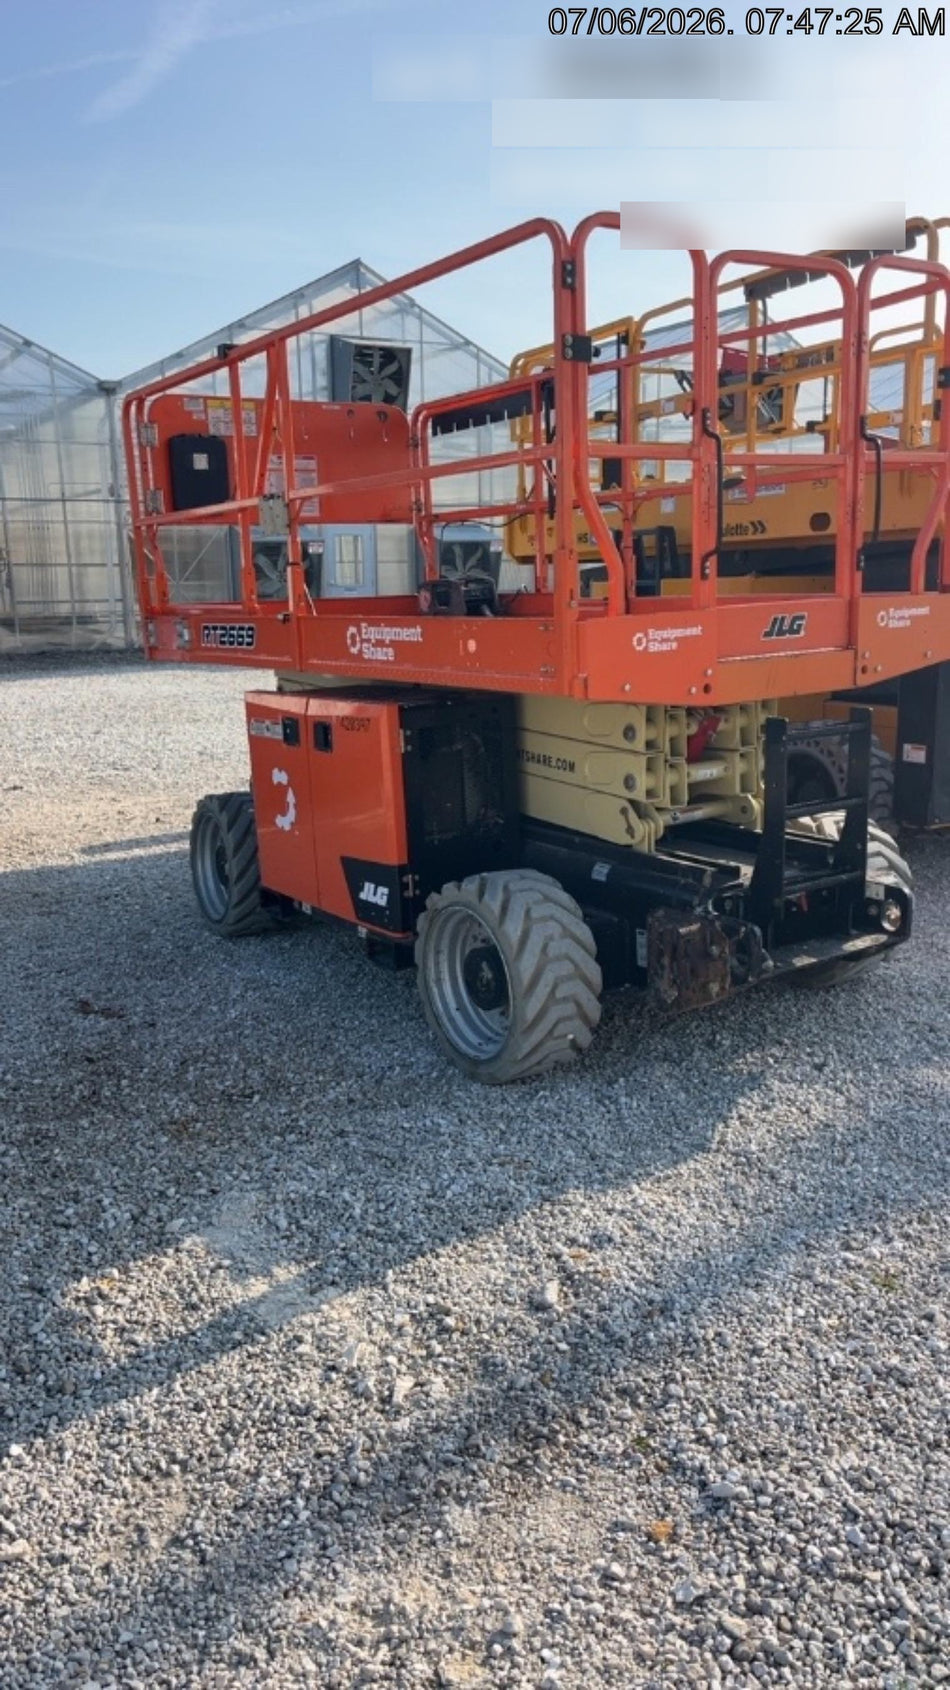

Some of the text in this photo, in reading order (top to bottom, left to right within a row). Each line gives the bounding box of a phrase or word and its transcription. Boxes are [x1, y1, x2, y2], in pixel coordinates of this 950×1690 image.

[201, 623, 256, 648] RT2669
[360, 622, 423, 644] Equipment
[647, 624, 703, 641] Equipment
[760, 612, 807, 640] JLG
[361, 643, 395, 660] Share
[647, 641, 678, 653] Share
[359, 881, 389, 907] JLG
